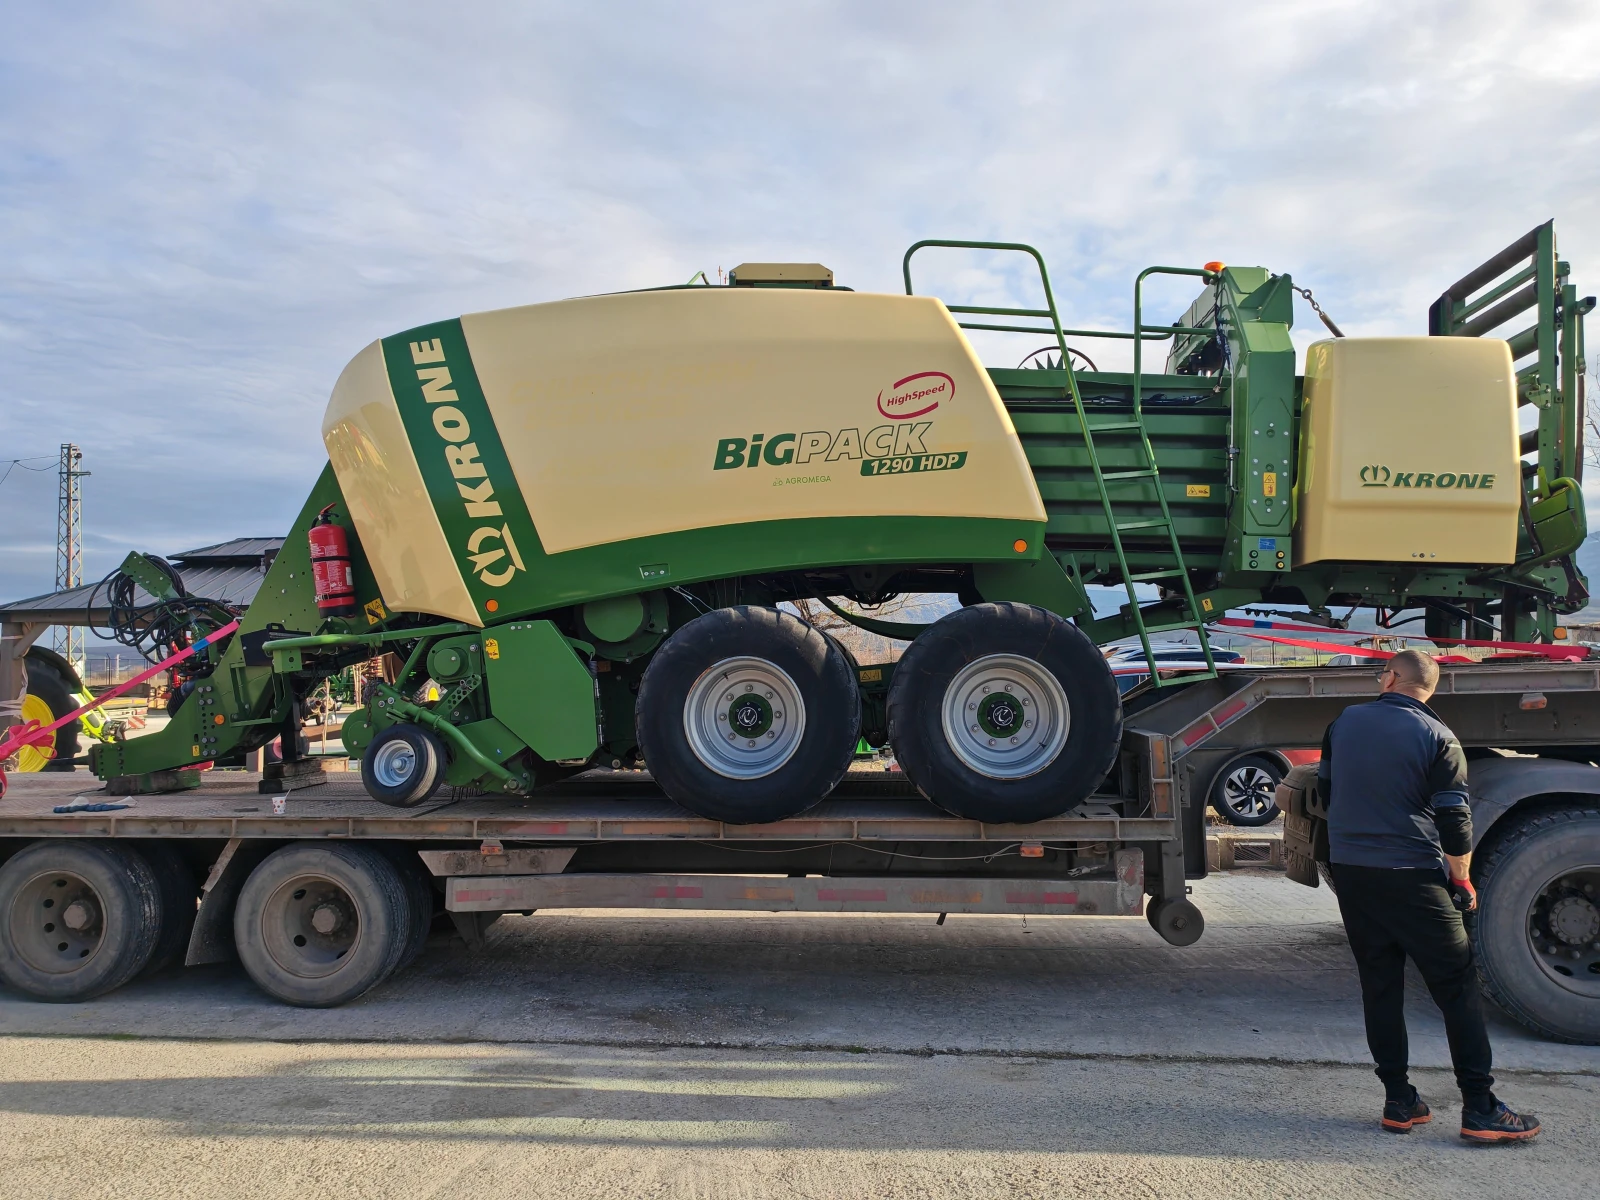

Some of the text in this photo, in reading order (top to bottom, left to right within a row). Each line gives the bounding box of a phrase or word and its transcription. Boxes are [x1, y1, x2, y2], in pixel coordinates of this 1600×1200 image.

[886, 382, 946, 407] HighSpeed
[409, 338, 503, 518] KRONE
[870, 453, 960, 475] 1290 HDP
[785, 475, 832, 485] AGROMEGA
[1392, 471, 1498, 490] KRONE
